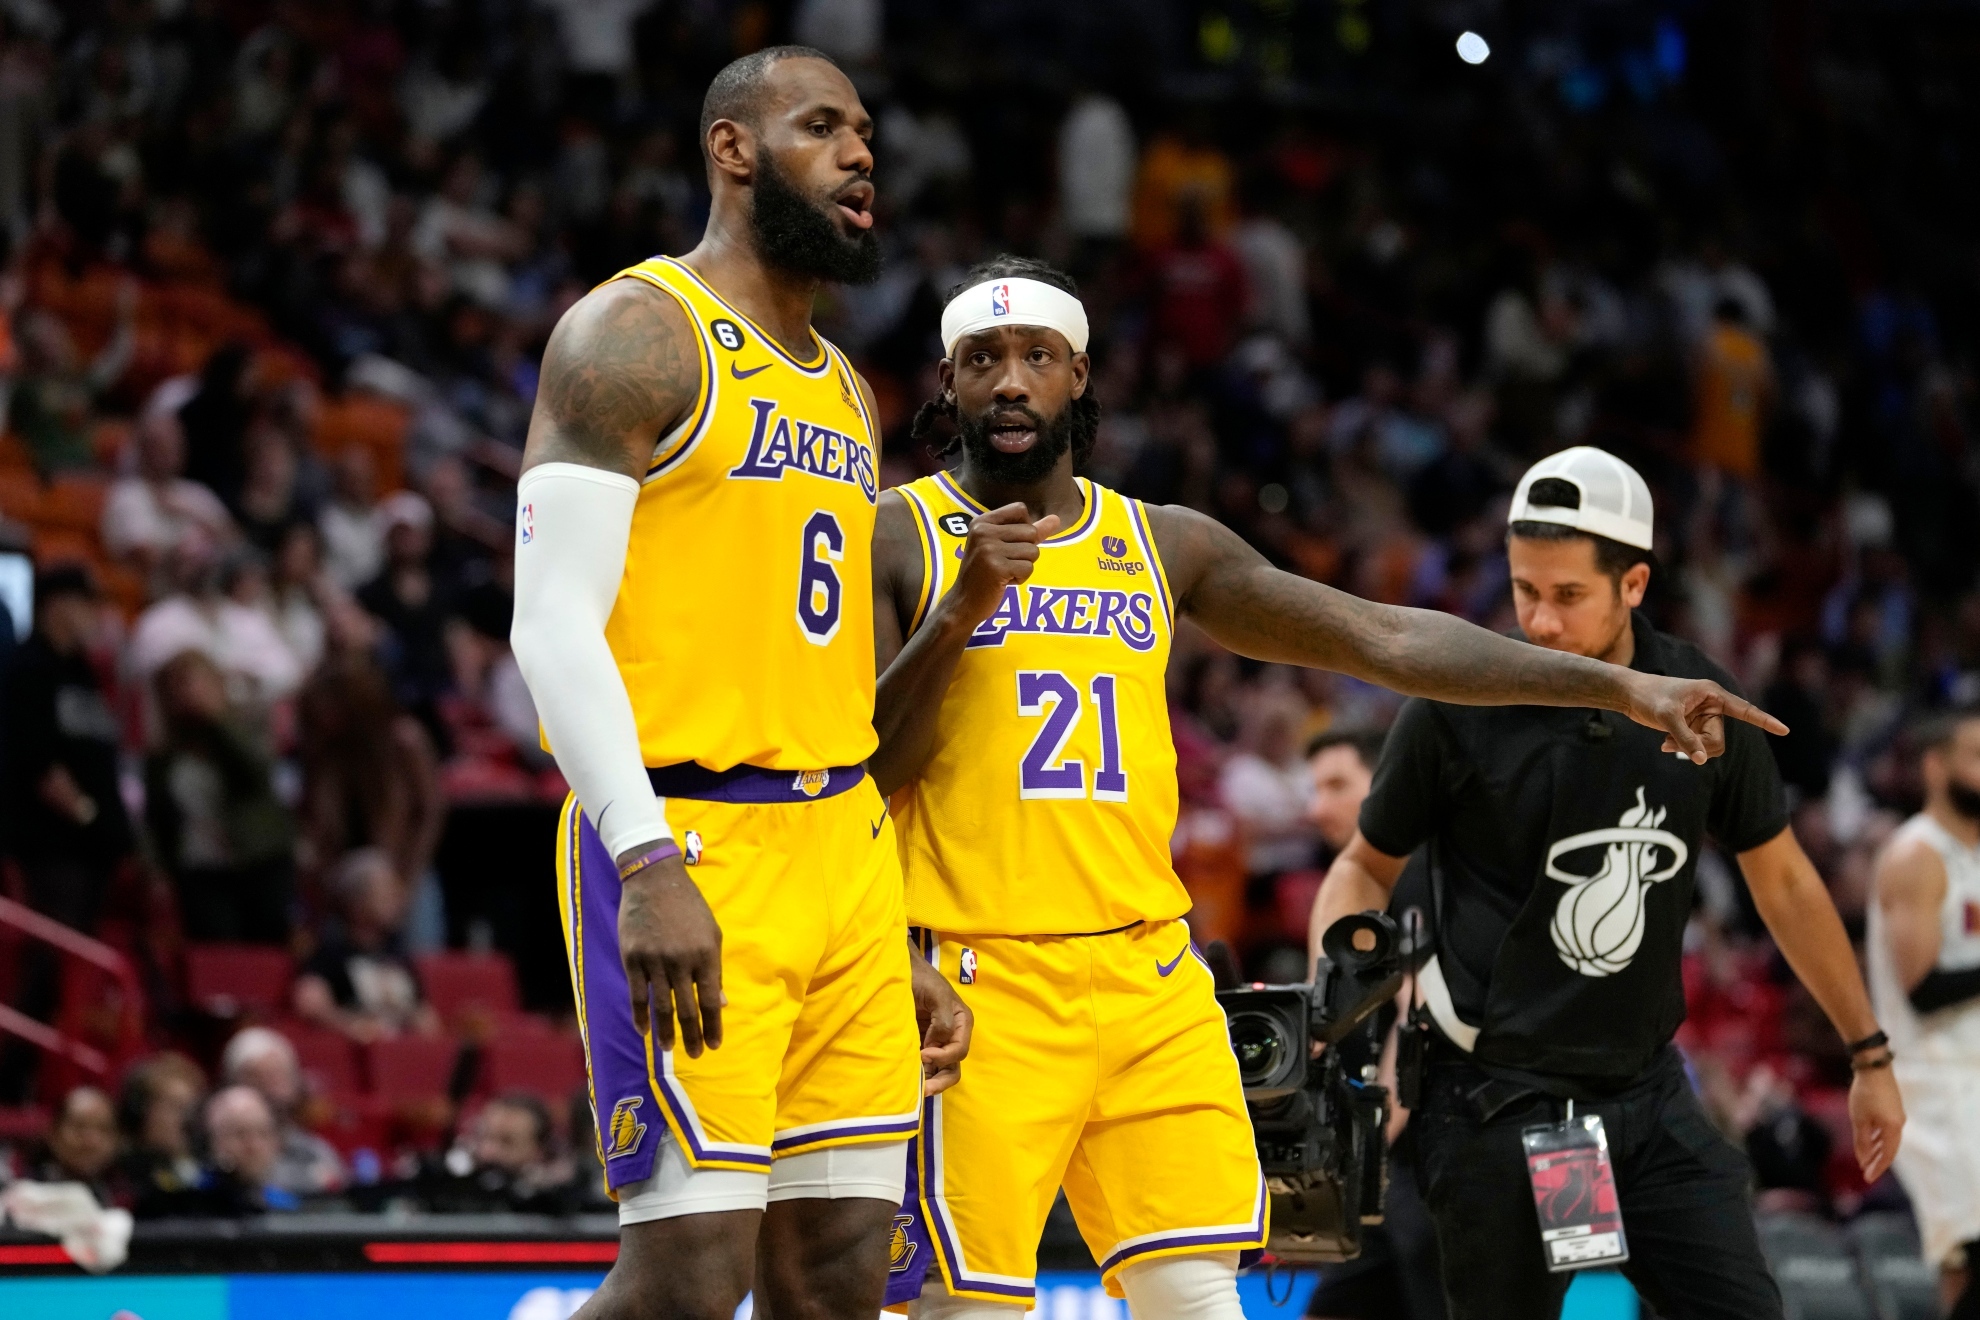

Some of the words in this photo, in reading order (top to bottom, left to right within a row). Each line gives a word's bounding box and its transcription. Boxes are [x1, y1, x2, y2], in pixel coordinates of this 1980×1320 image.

[715, 322, 739, 348] 6
[726, 397, 879, 506] LAKERS
[945, 516, 969, 535] 6
[795, 508, 846, 647] 6
[1098, 557, 1145, 576] bibigo
[965, 584, 1157, 653] AKERS
[1016, 669, 1128, 803] 21
